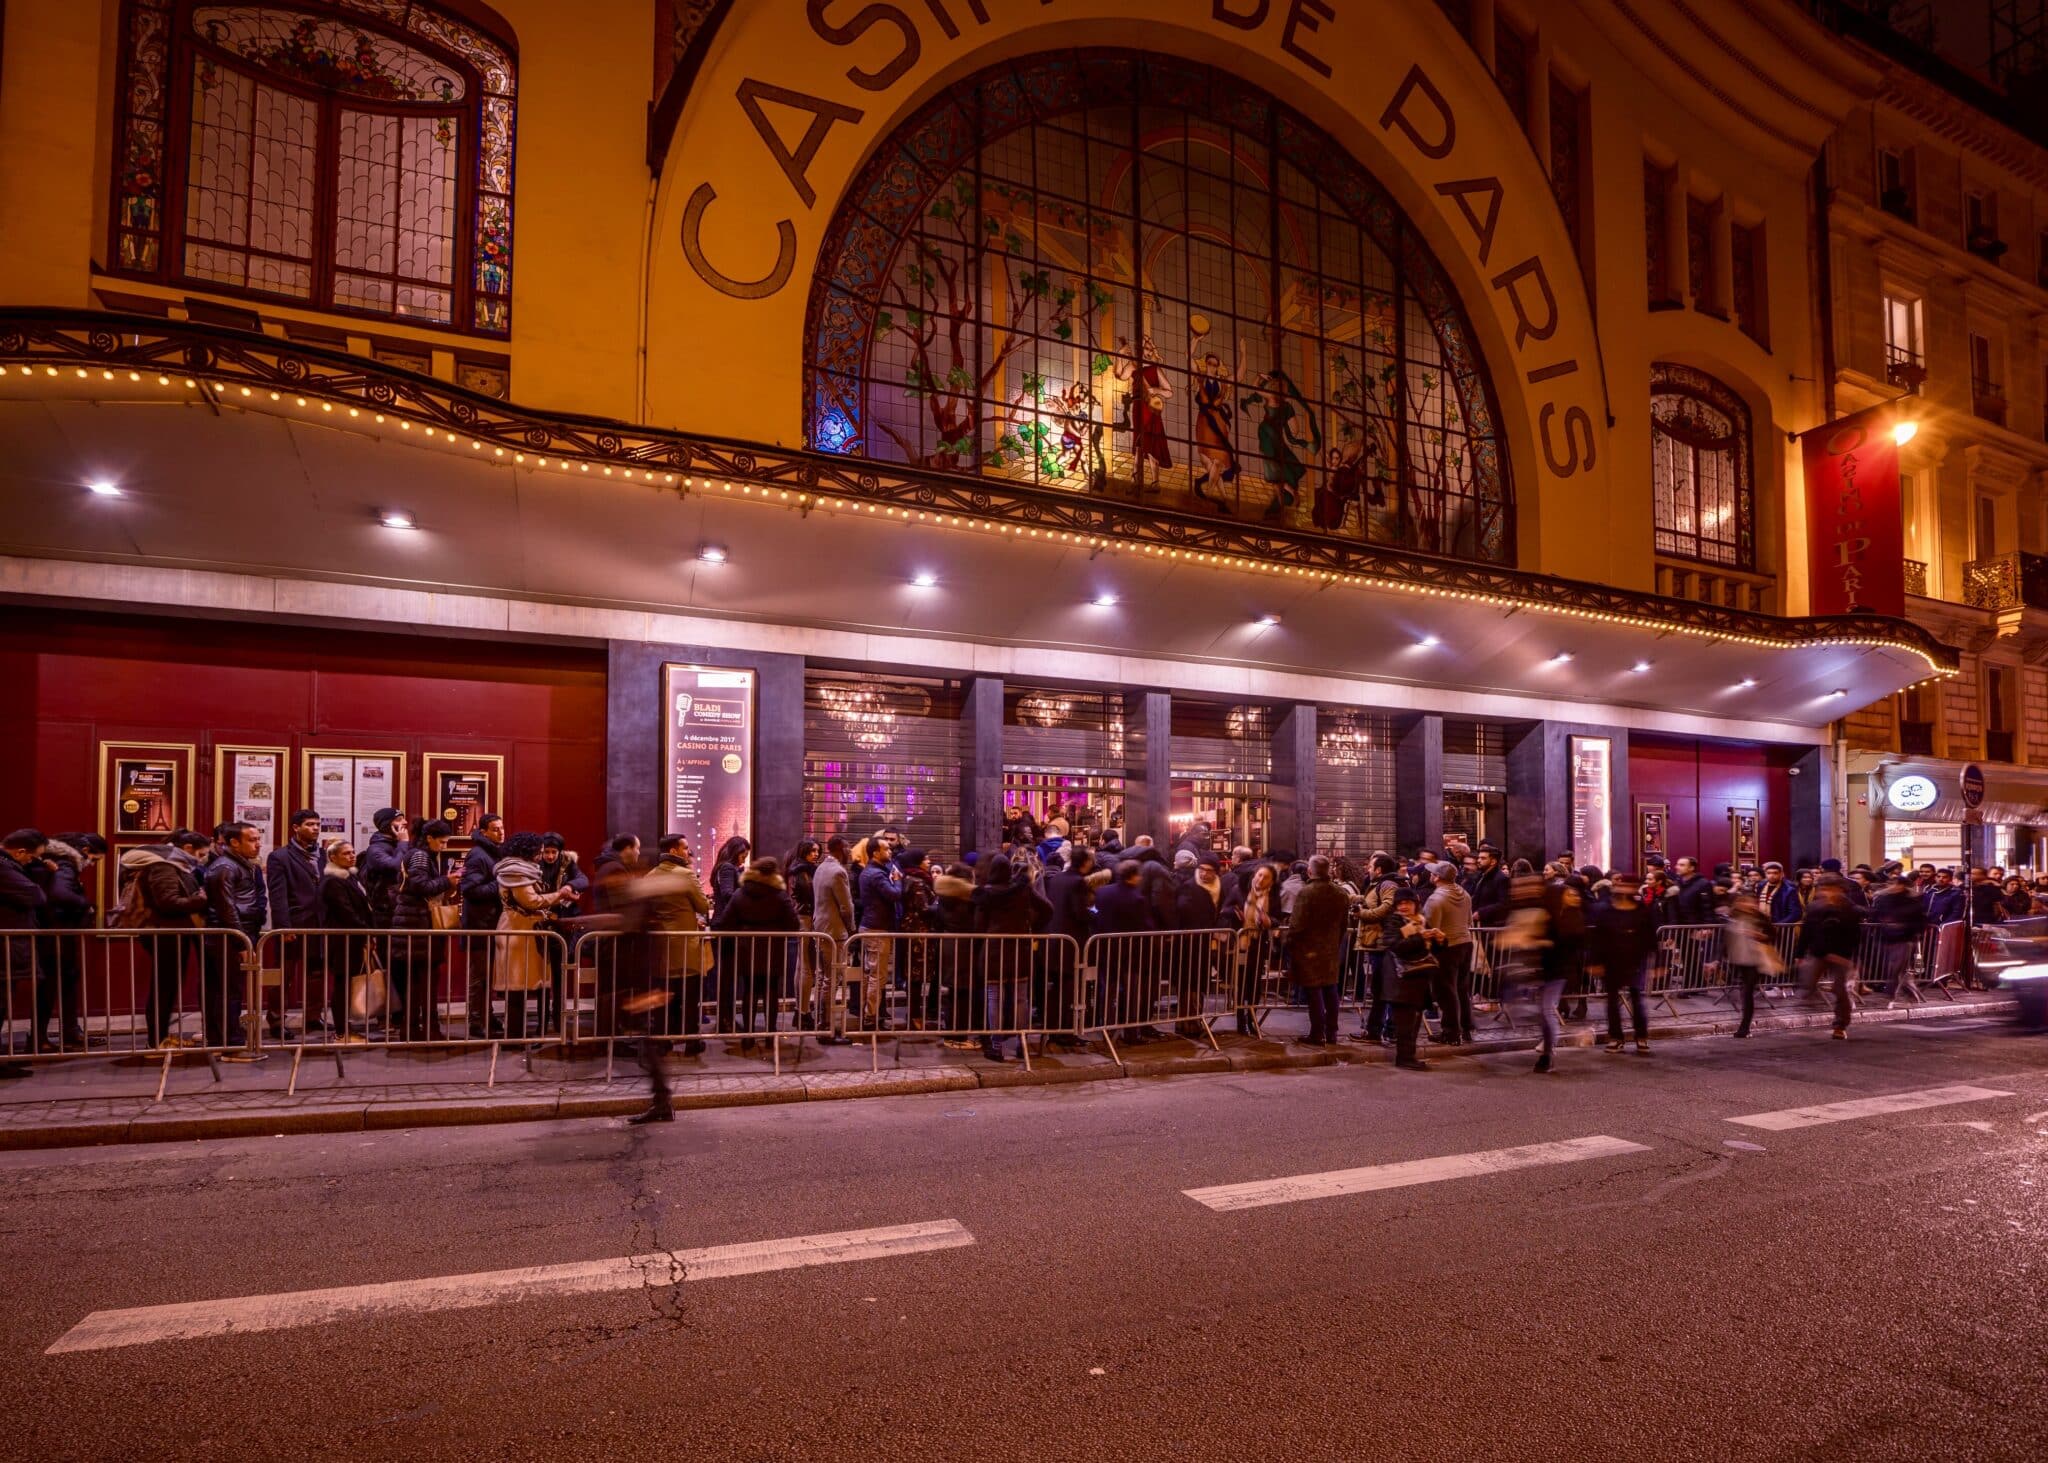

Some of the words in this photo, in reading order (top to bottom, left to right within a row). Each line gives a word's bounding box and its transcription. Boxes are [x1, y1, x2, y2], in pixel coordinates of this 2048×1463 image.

[680, 0, 1054, 300] CASI
[1380, 65, 1597, 480] PARIS
[693, 703, 721, 712] BLADI
[677, 742, 707, 750] CASINO
